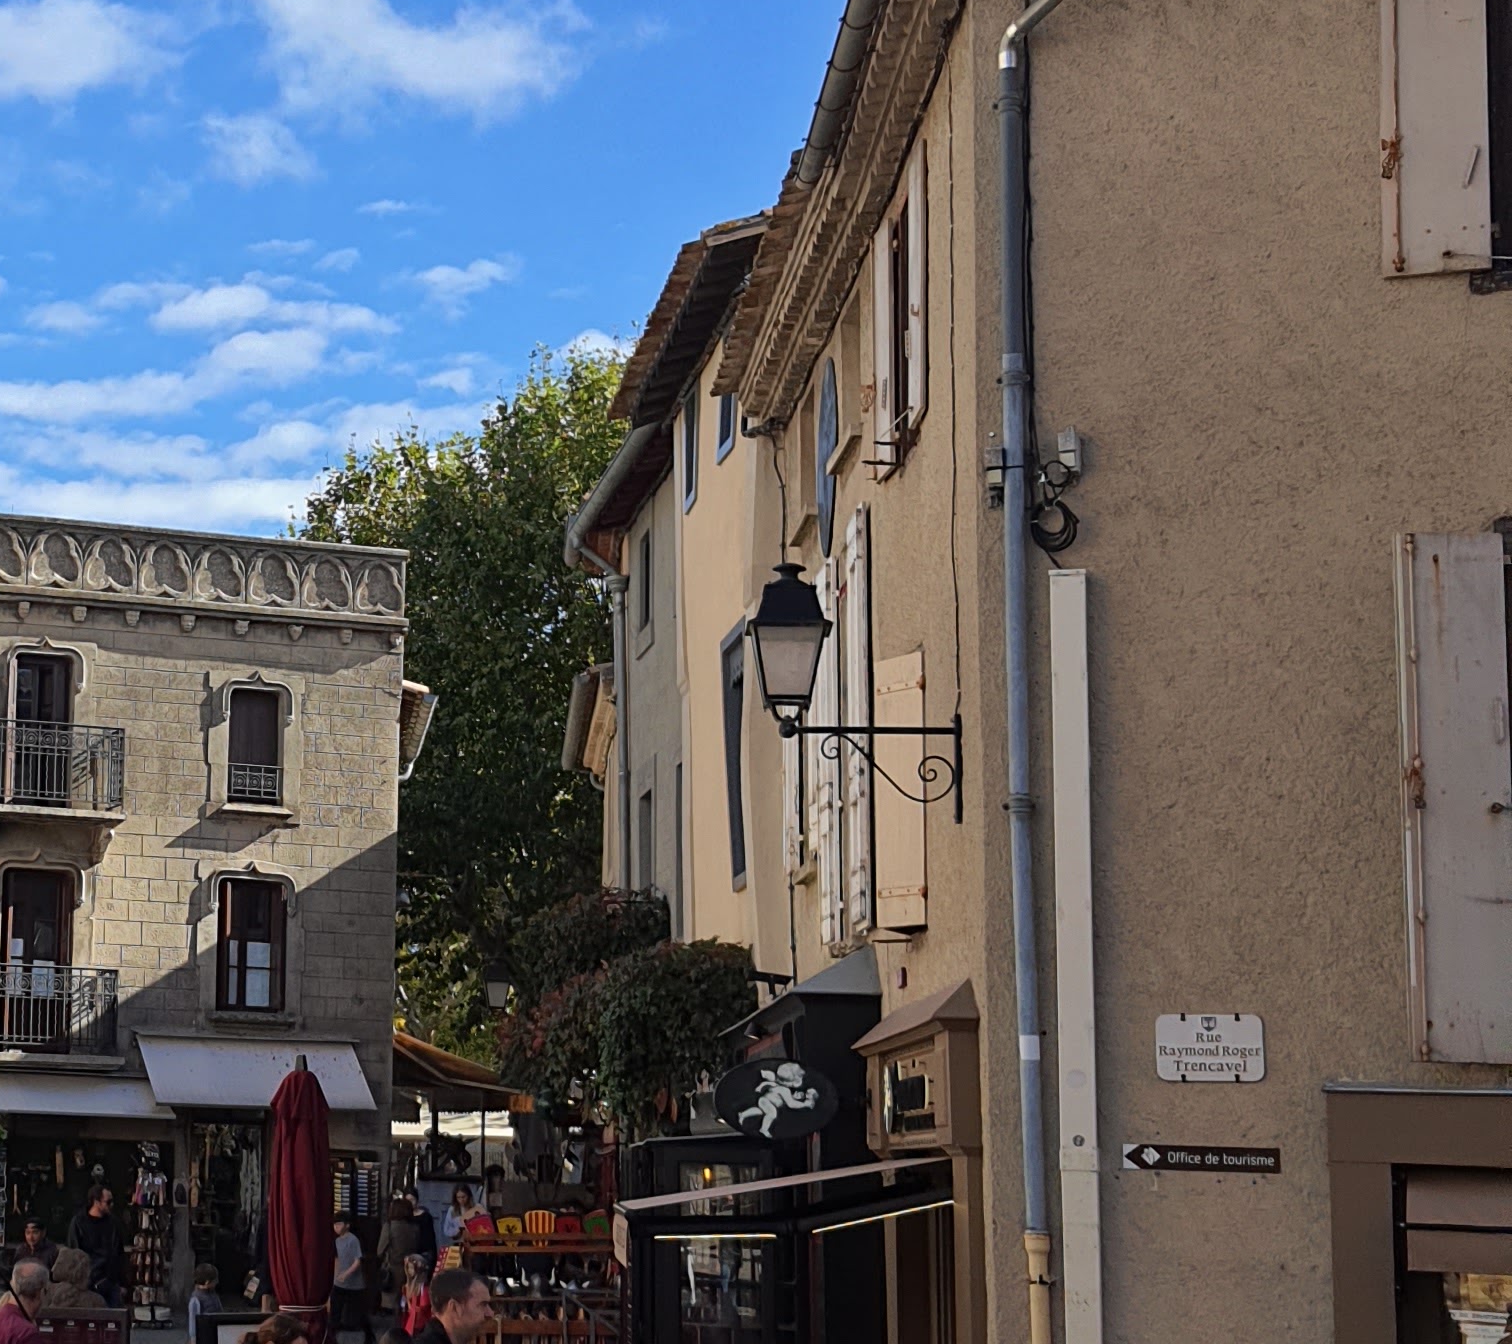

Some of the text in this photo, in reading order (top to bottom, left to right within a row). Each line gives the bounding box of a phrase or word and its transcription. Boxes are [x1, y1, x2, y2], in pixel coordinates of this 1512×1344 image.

[1195, 1032, 1222, 1043] Rue
[1159, 1045, 1261, 1059] Raymond Roger
[1173, 1060, 1248, 1073] Trencavel
[1167, 1150, 1275, 1167] Office de tourisme
